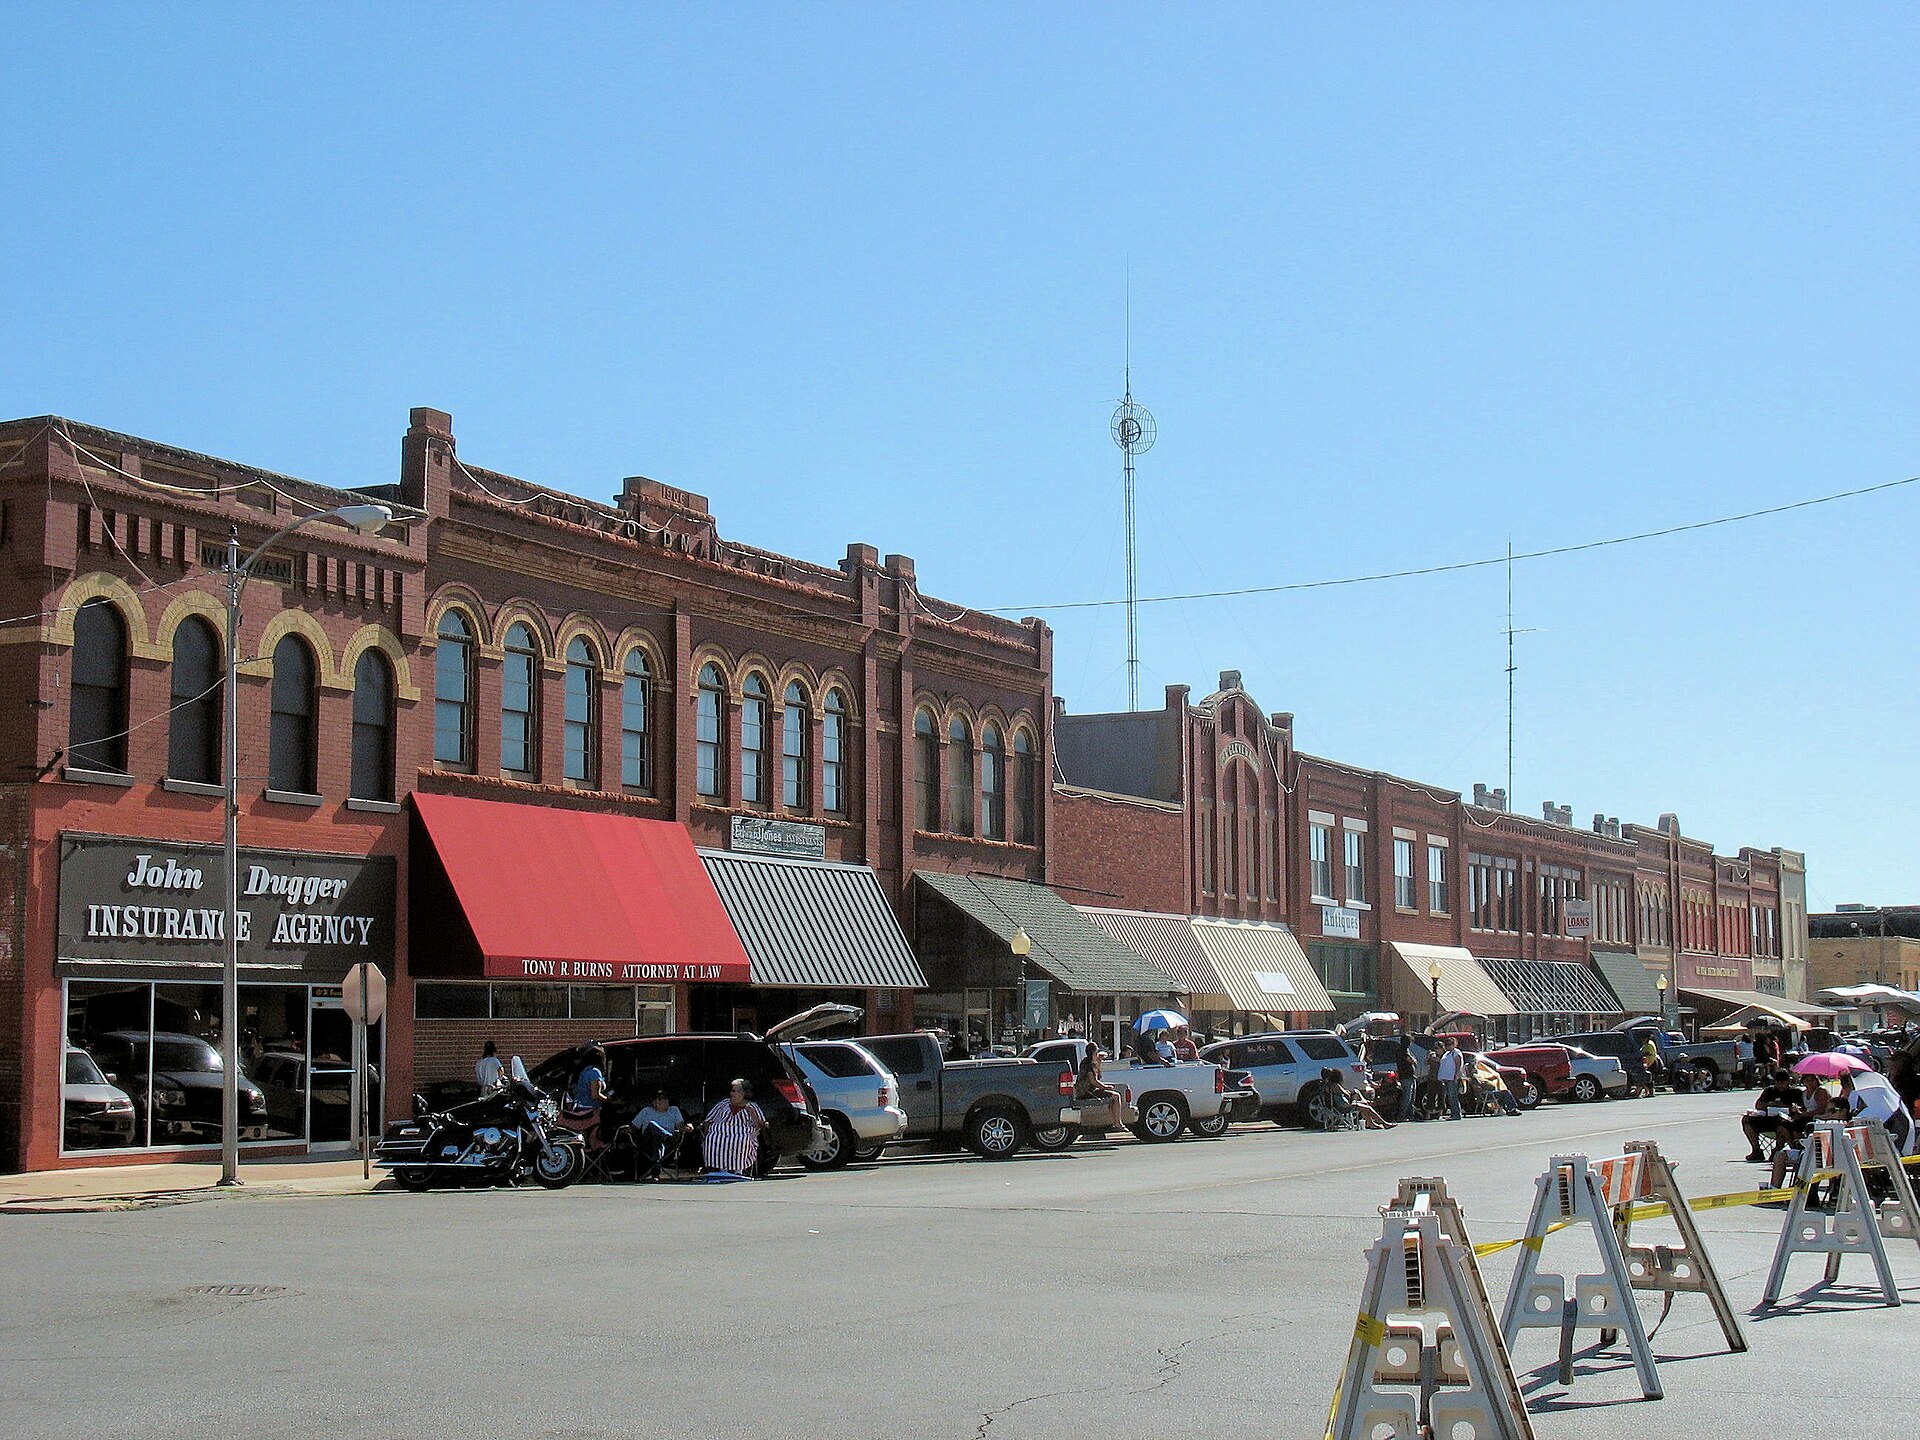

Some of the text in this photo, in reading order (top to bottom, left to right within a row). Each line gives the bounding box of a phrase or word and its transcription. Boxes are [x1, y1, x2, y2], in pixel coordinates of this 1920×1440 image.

[128, 855, 347, 905] John Dugger
[272, 913, 374, 945] AGENCY
[1324, 910, 1359, 933] Antiques
[1567, 917, 1590, 928] LOANS
[522, 960, 555, 976] TONY
[573, 962, 613, 978] BURNS
[621, 964, 679, 979] ATTORNEY
[683, 965, 696, 979] AT
[700, 965, 722, 979] LAW
